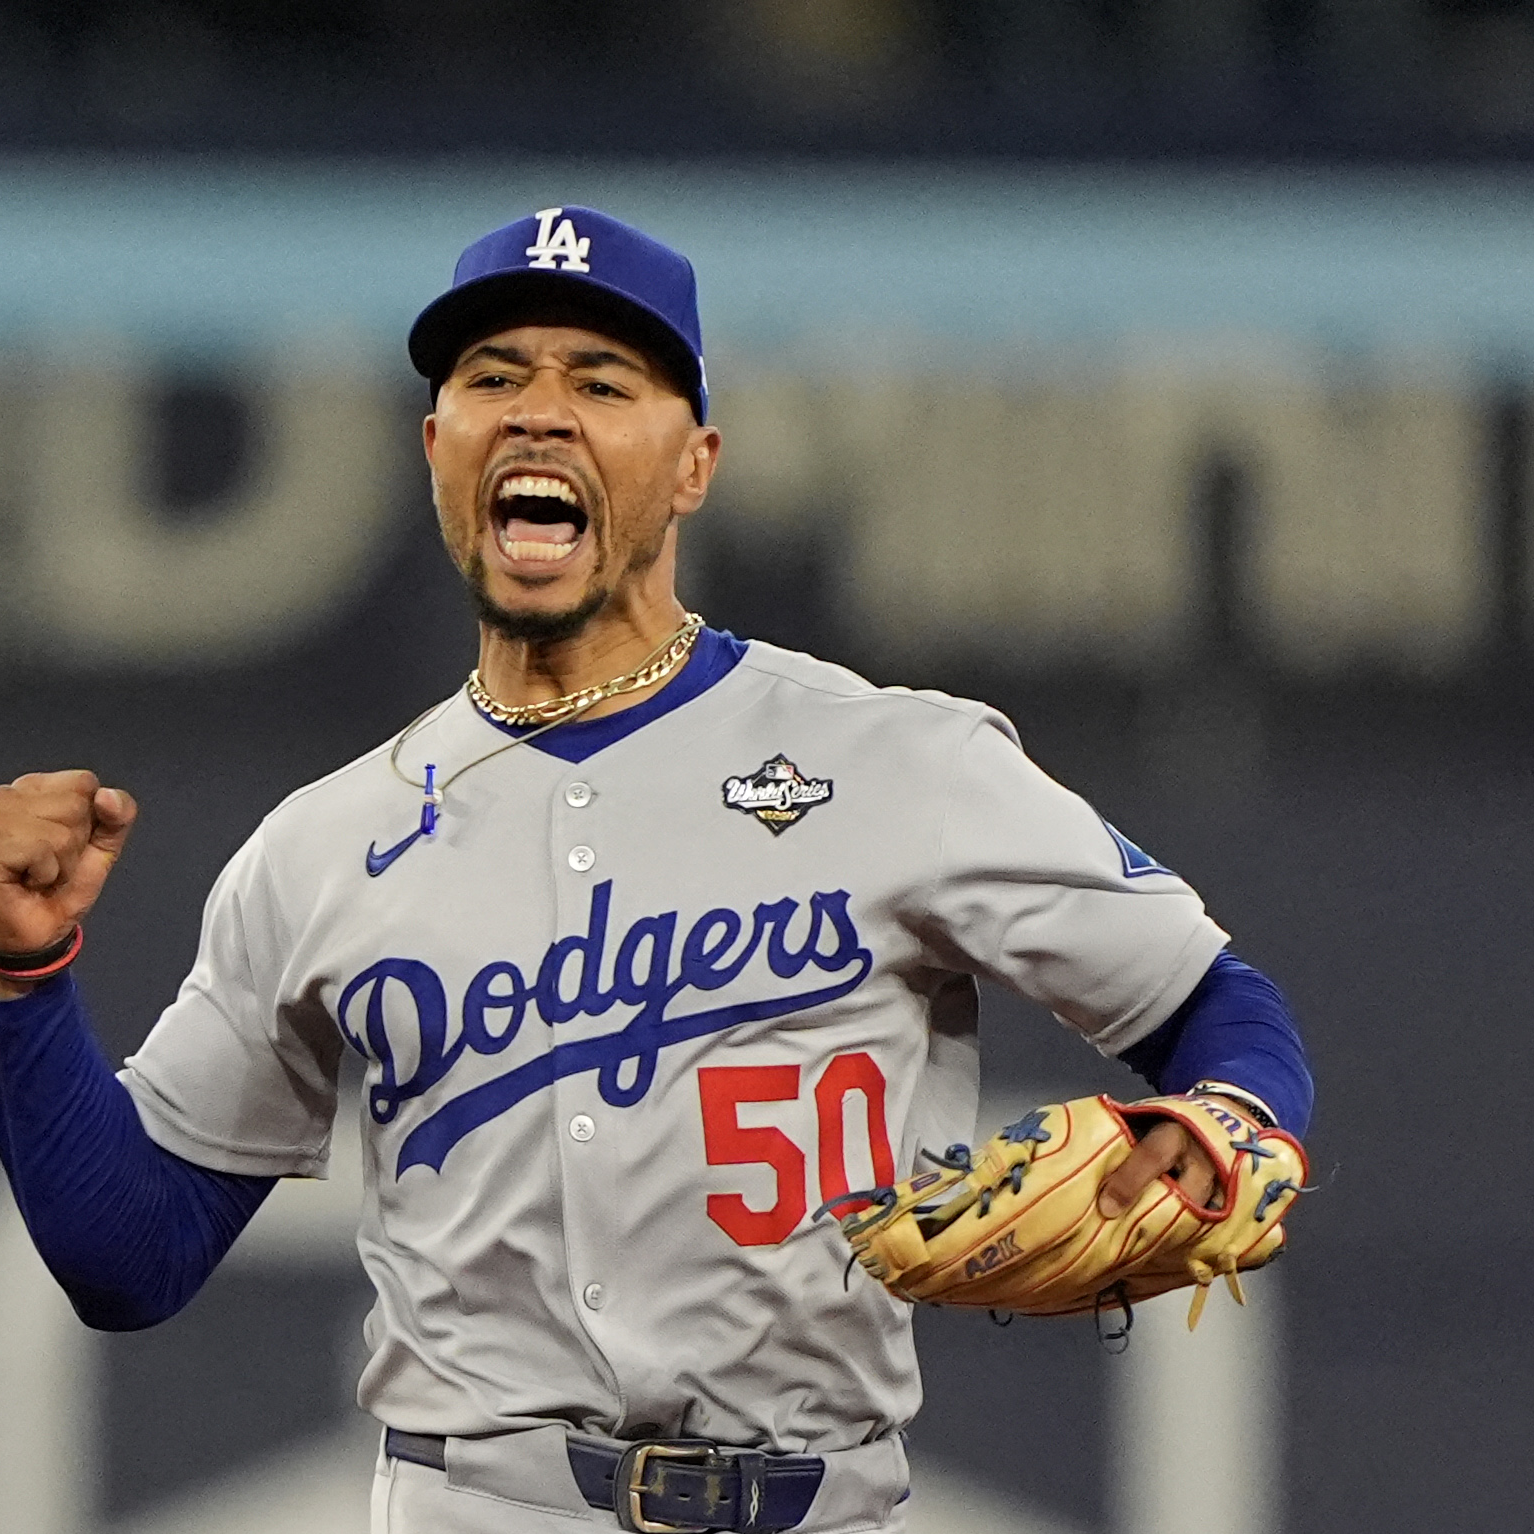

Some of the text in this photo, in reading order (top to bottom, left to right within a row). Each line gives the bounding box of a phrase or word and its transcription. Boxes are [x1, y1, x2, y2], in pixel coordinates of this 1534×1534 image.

[526, 207, 590, 273] LA
[775, 779, 830, 811] Series
[338, 879, 873, 1165] Dodgers
[697, 1052, 896, 1247] 50
